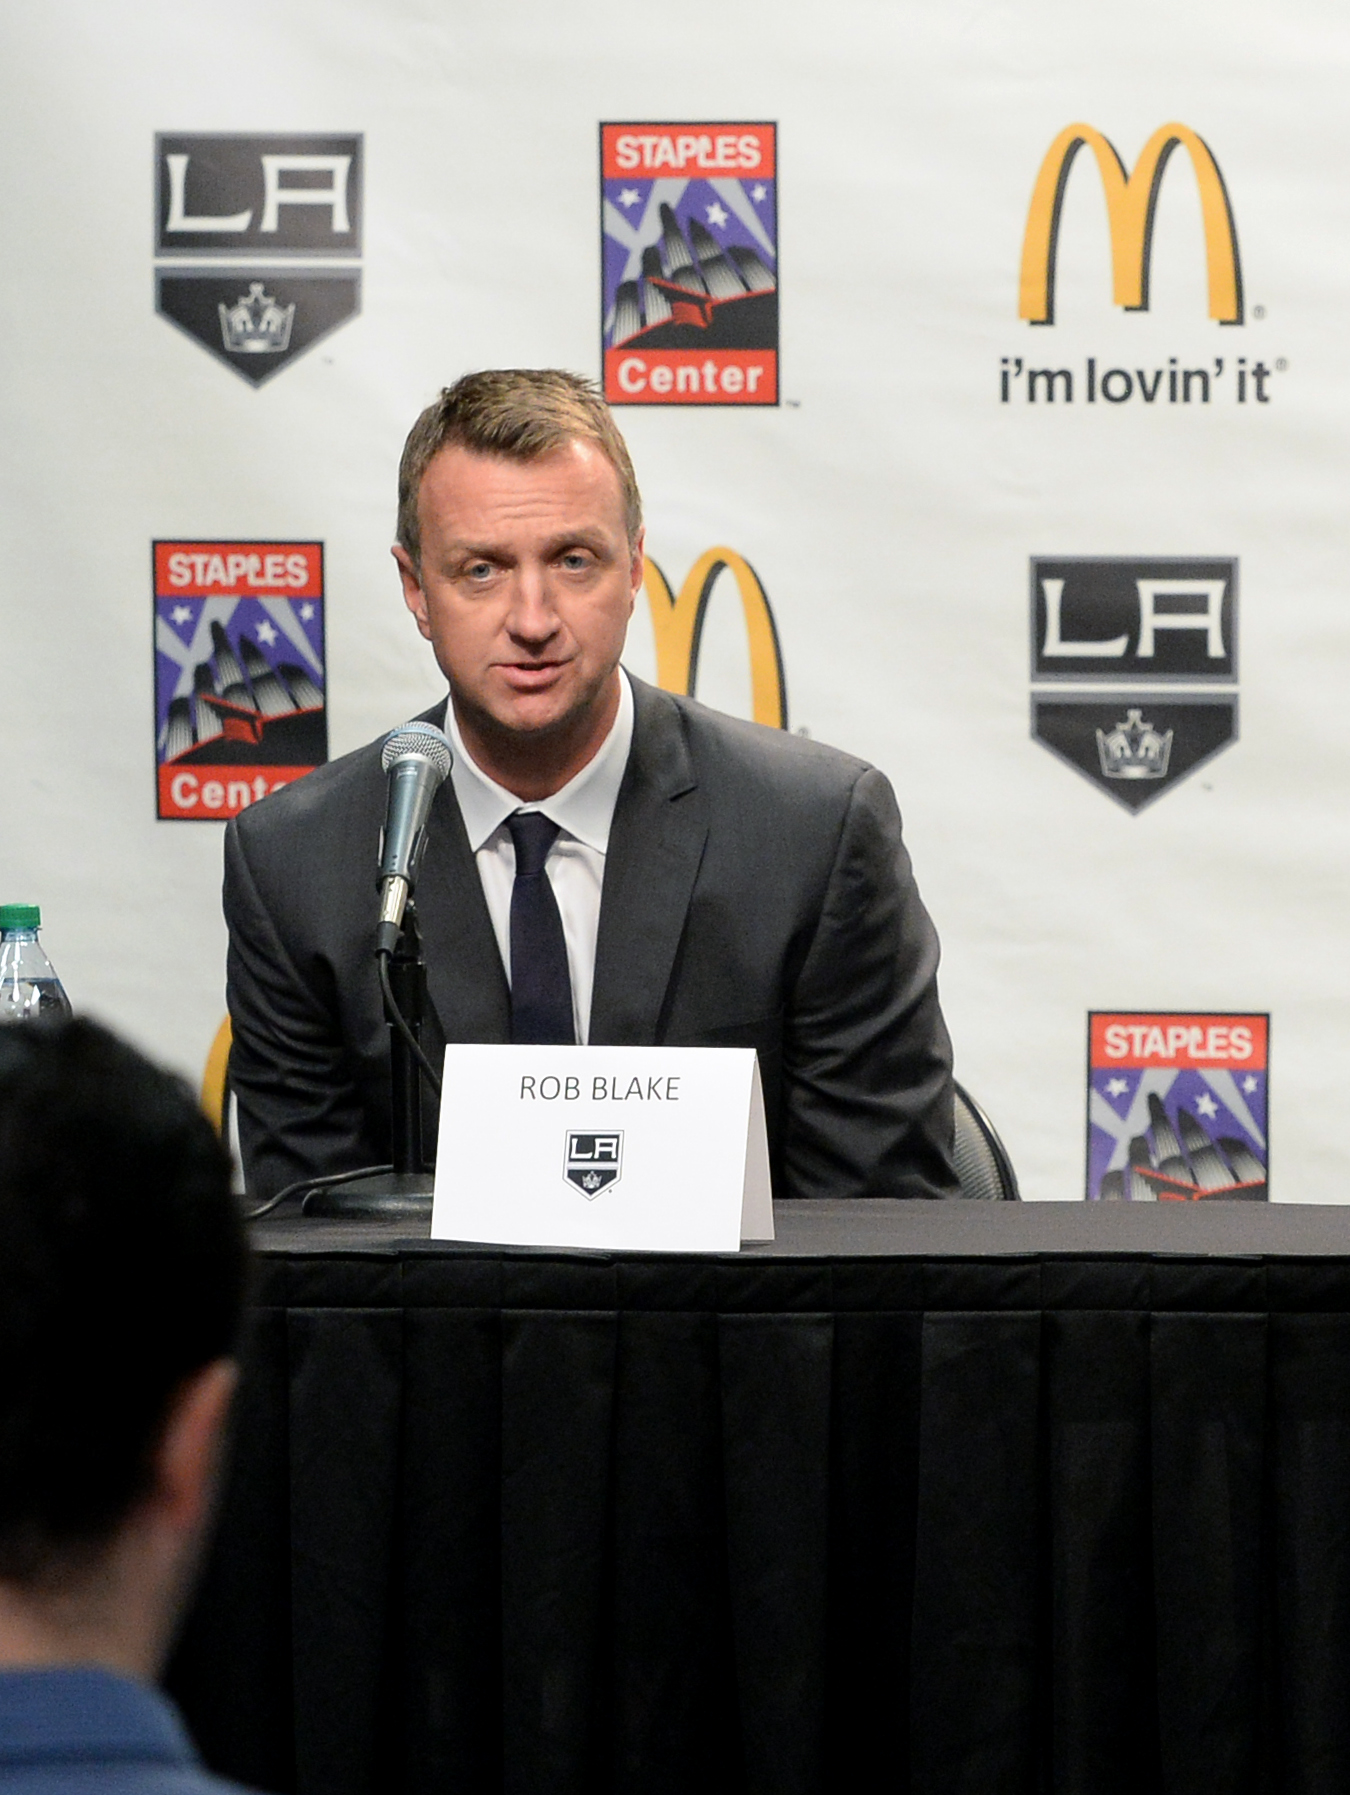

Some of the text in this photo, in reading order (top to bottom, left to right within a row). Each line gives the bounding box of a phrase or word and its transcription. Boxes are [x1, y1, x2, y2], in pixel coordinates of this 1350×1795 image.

[615, 134, 762, 169] STAPLES
[166, 154, 352, 233] LA
[617, 357, 764, 394] Center
[1001, 357, 1073, 403] i'm
[168, 553, 309, 587] STAPLES
[1042, 579, 1227, 657] LA
[171, 772, 287, 809] Cent
[1104, 1024, 1254, 1061] STAPLES
[520, 1075, 681, 1101] ROB BLAKE
[570, 1137, 618, 1159] LA
